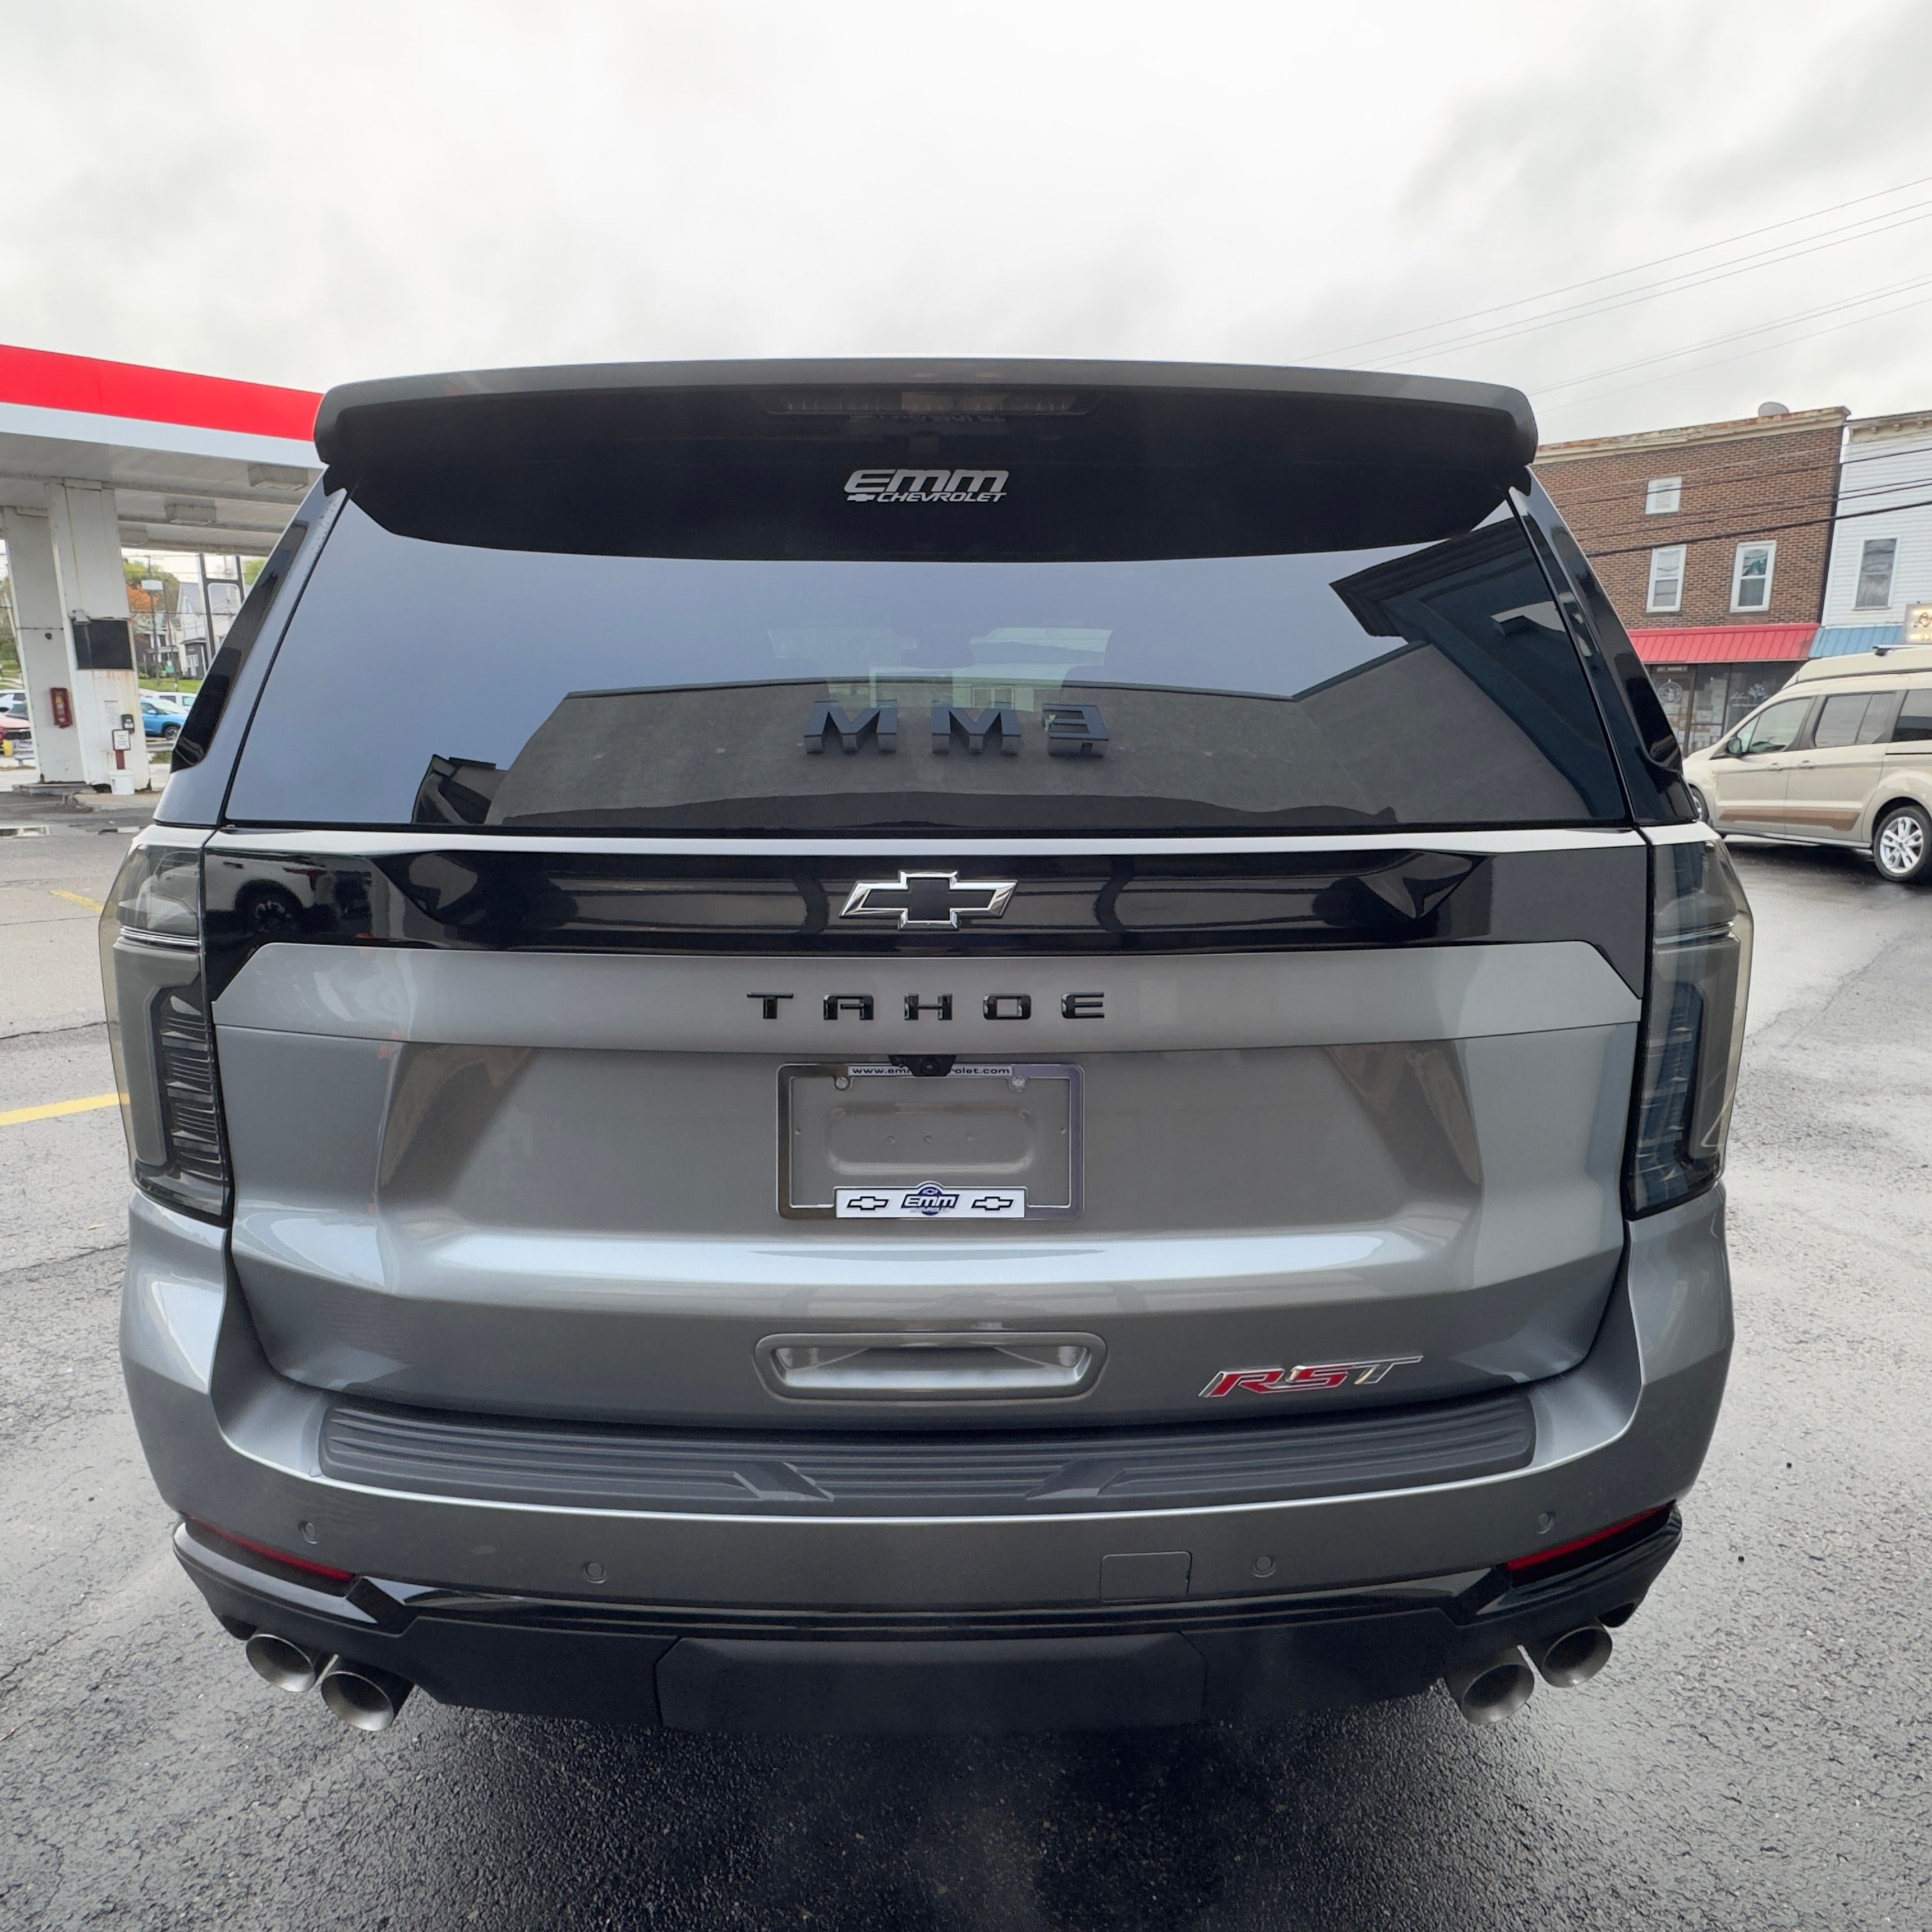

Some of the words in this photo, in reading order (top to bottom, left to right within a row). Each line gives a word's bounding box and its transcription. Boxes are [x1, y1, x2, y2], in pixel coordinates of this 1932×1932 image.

[877, 492, 1008, 502] CHEVROLET
[747, 992, 1105, 1020] TAHOE
[1199, 1354, 1423, 1397] RST
